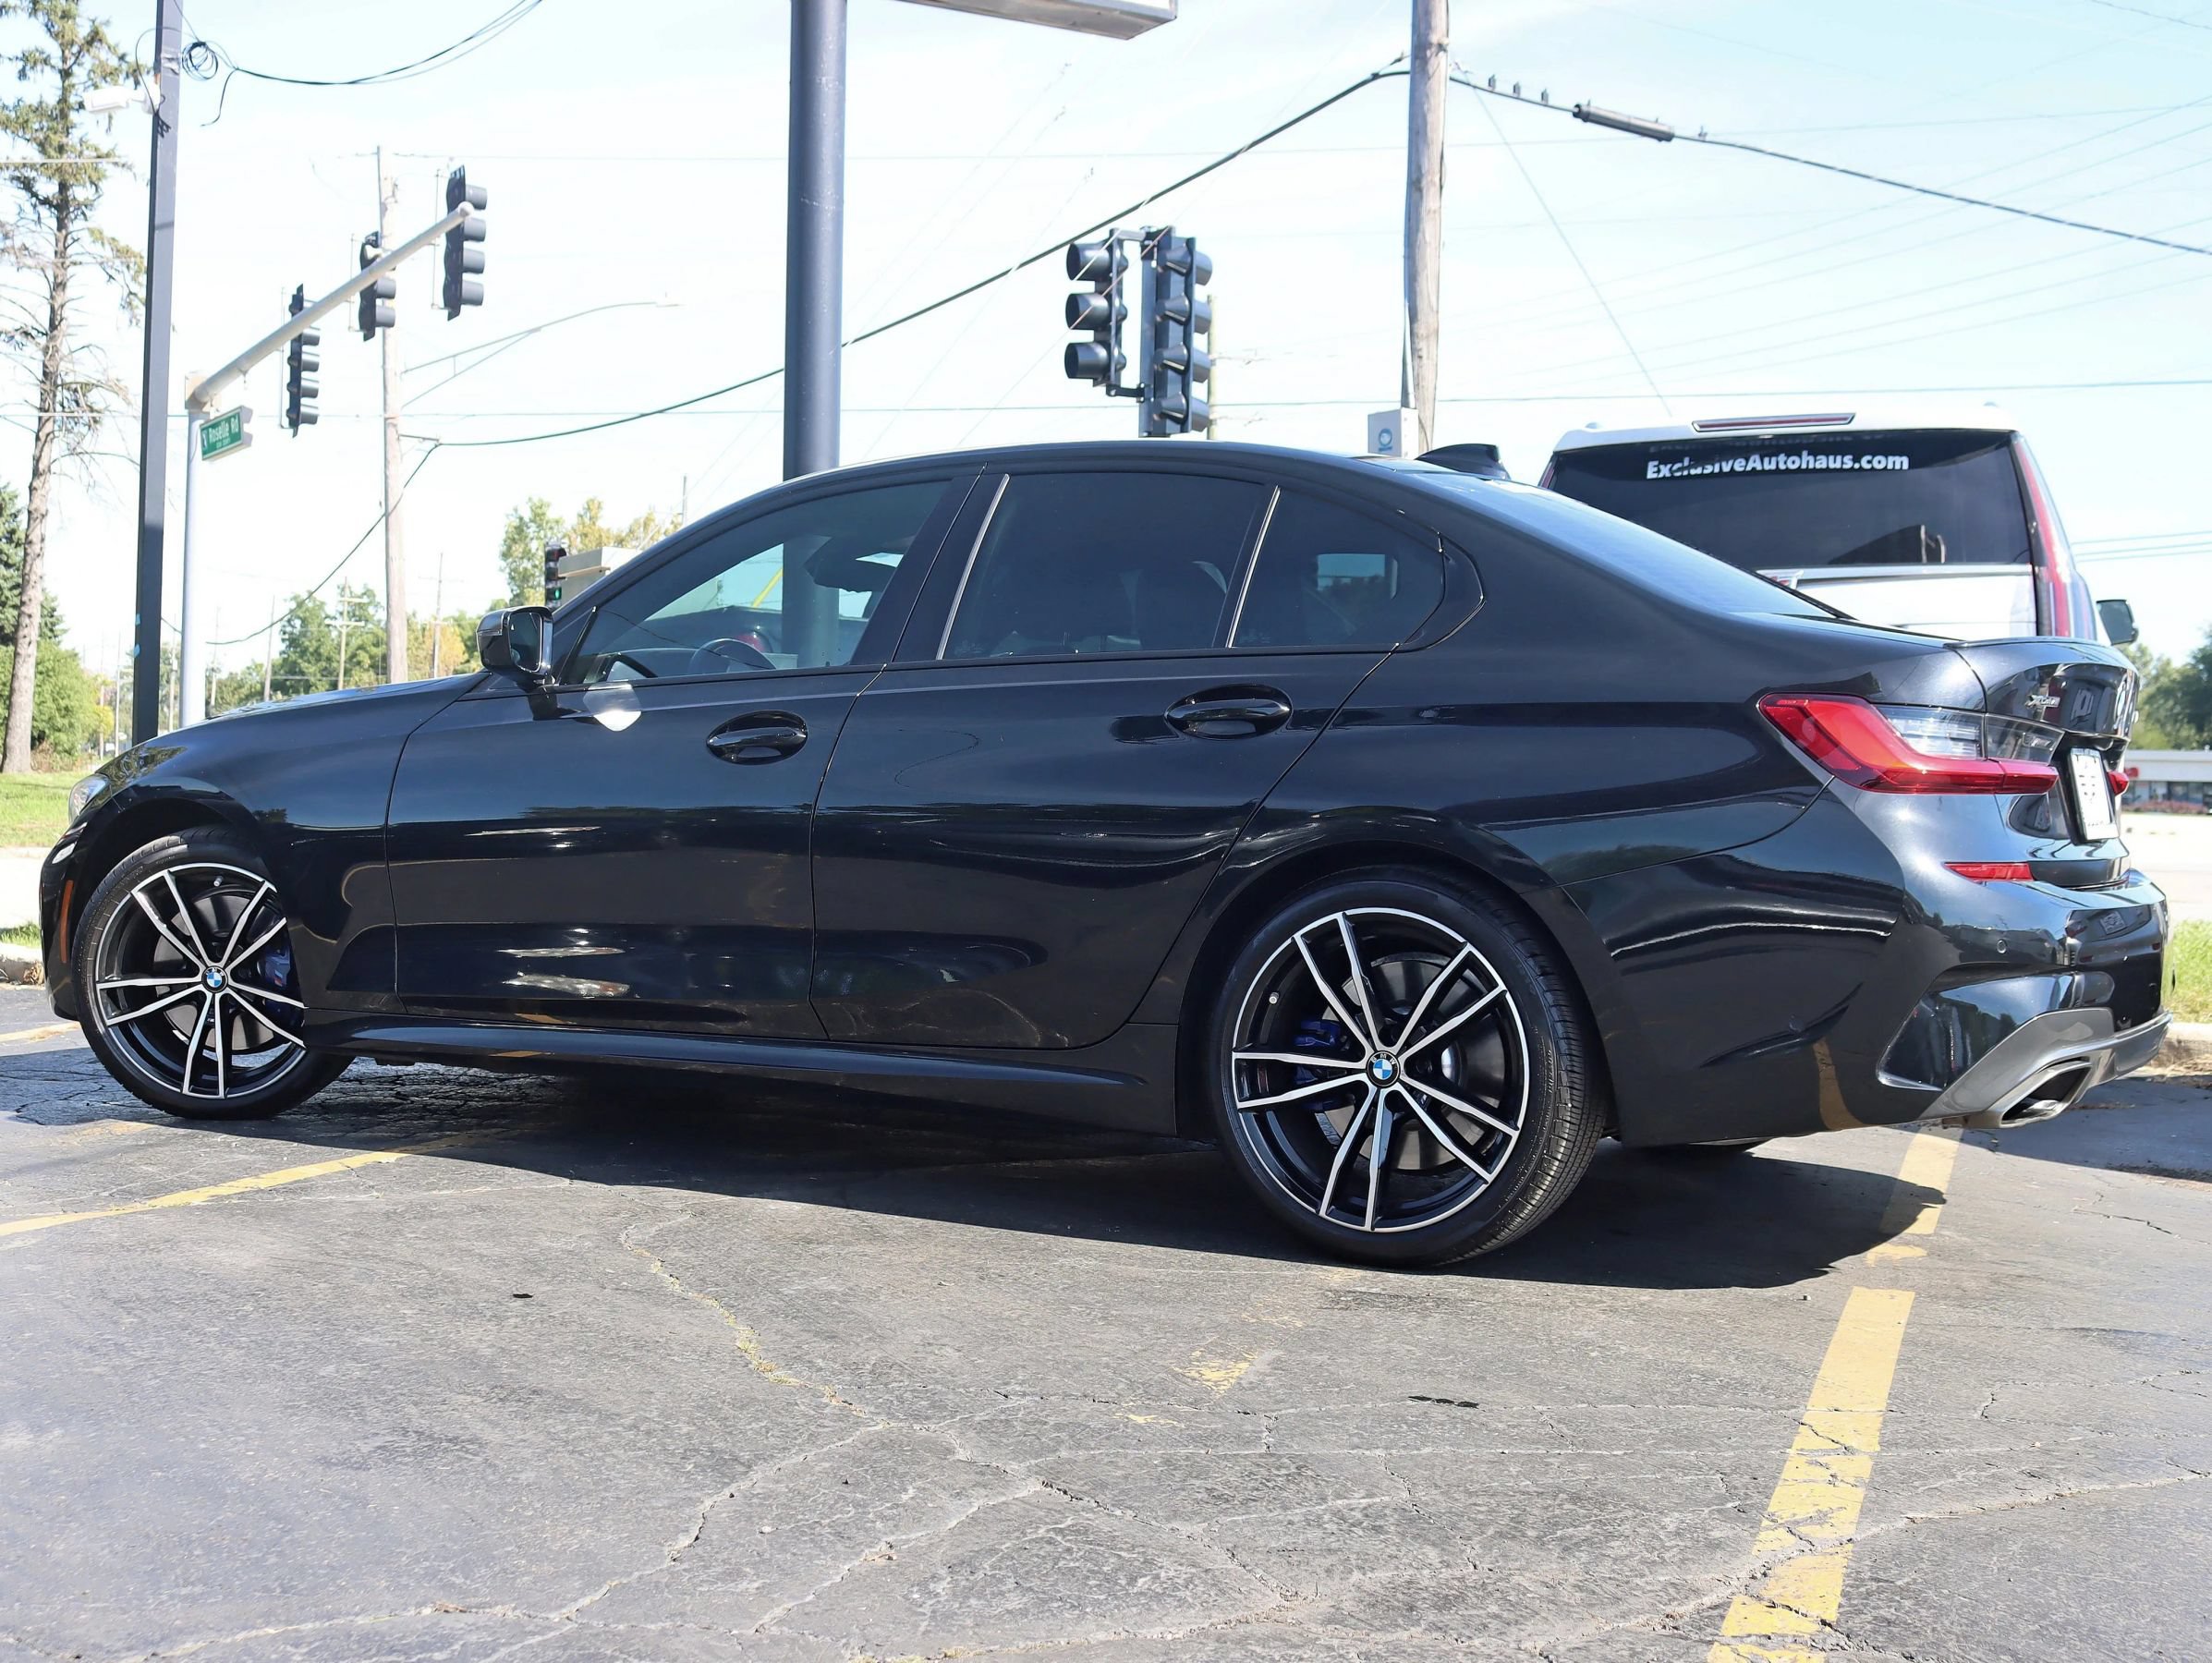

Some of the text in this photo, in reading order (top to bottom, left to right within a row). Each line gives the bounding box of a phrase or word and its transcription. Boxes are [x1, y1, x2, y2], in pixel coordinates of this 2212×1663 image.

[208, 420, 230, 443] Roselle
[230, 414, 239, 434] Rd
[1647, 450, 1910, 479] ExclusiveAutohaus.com
